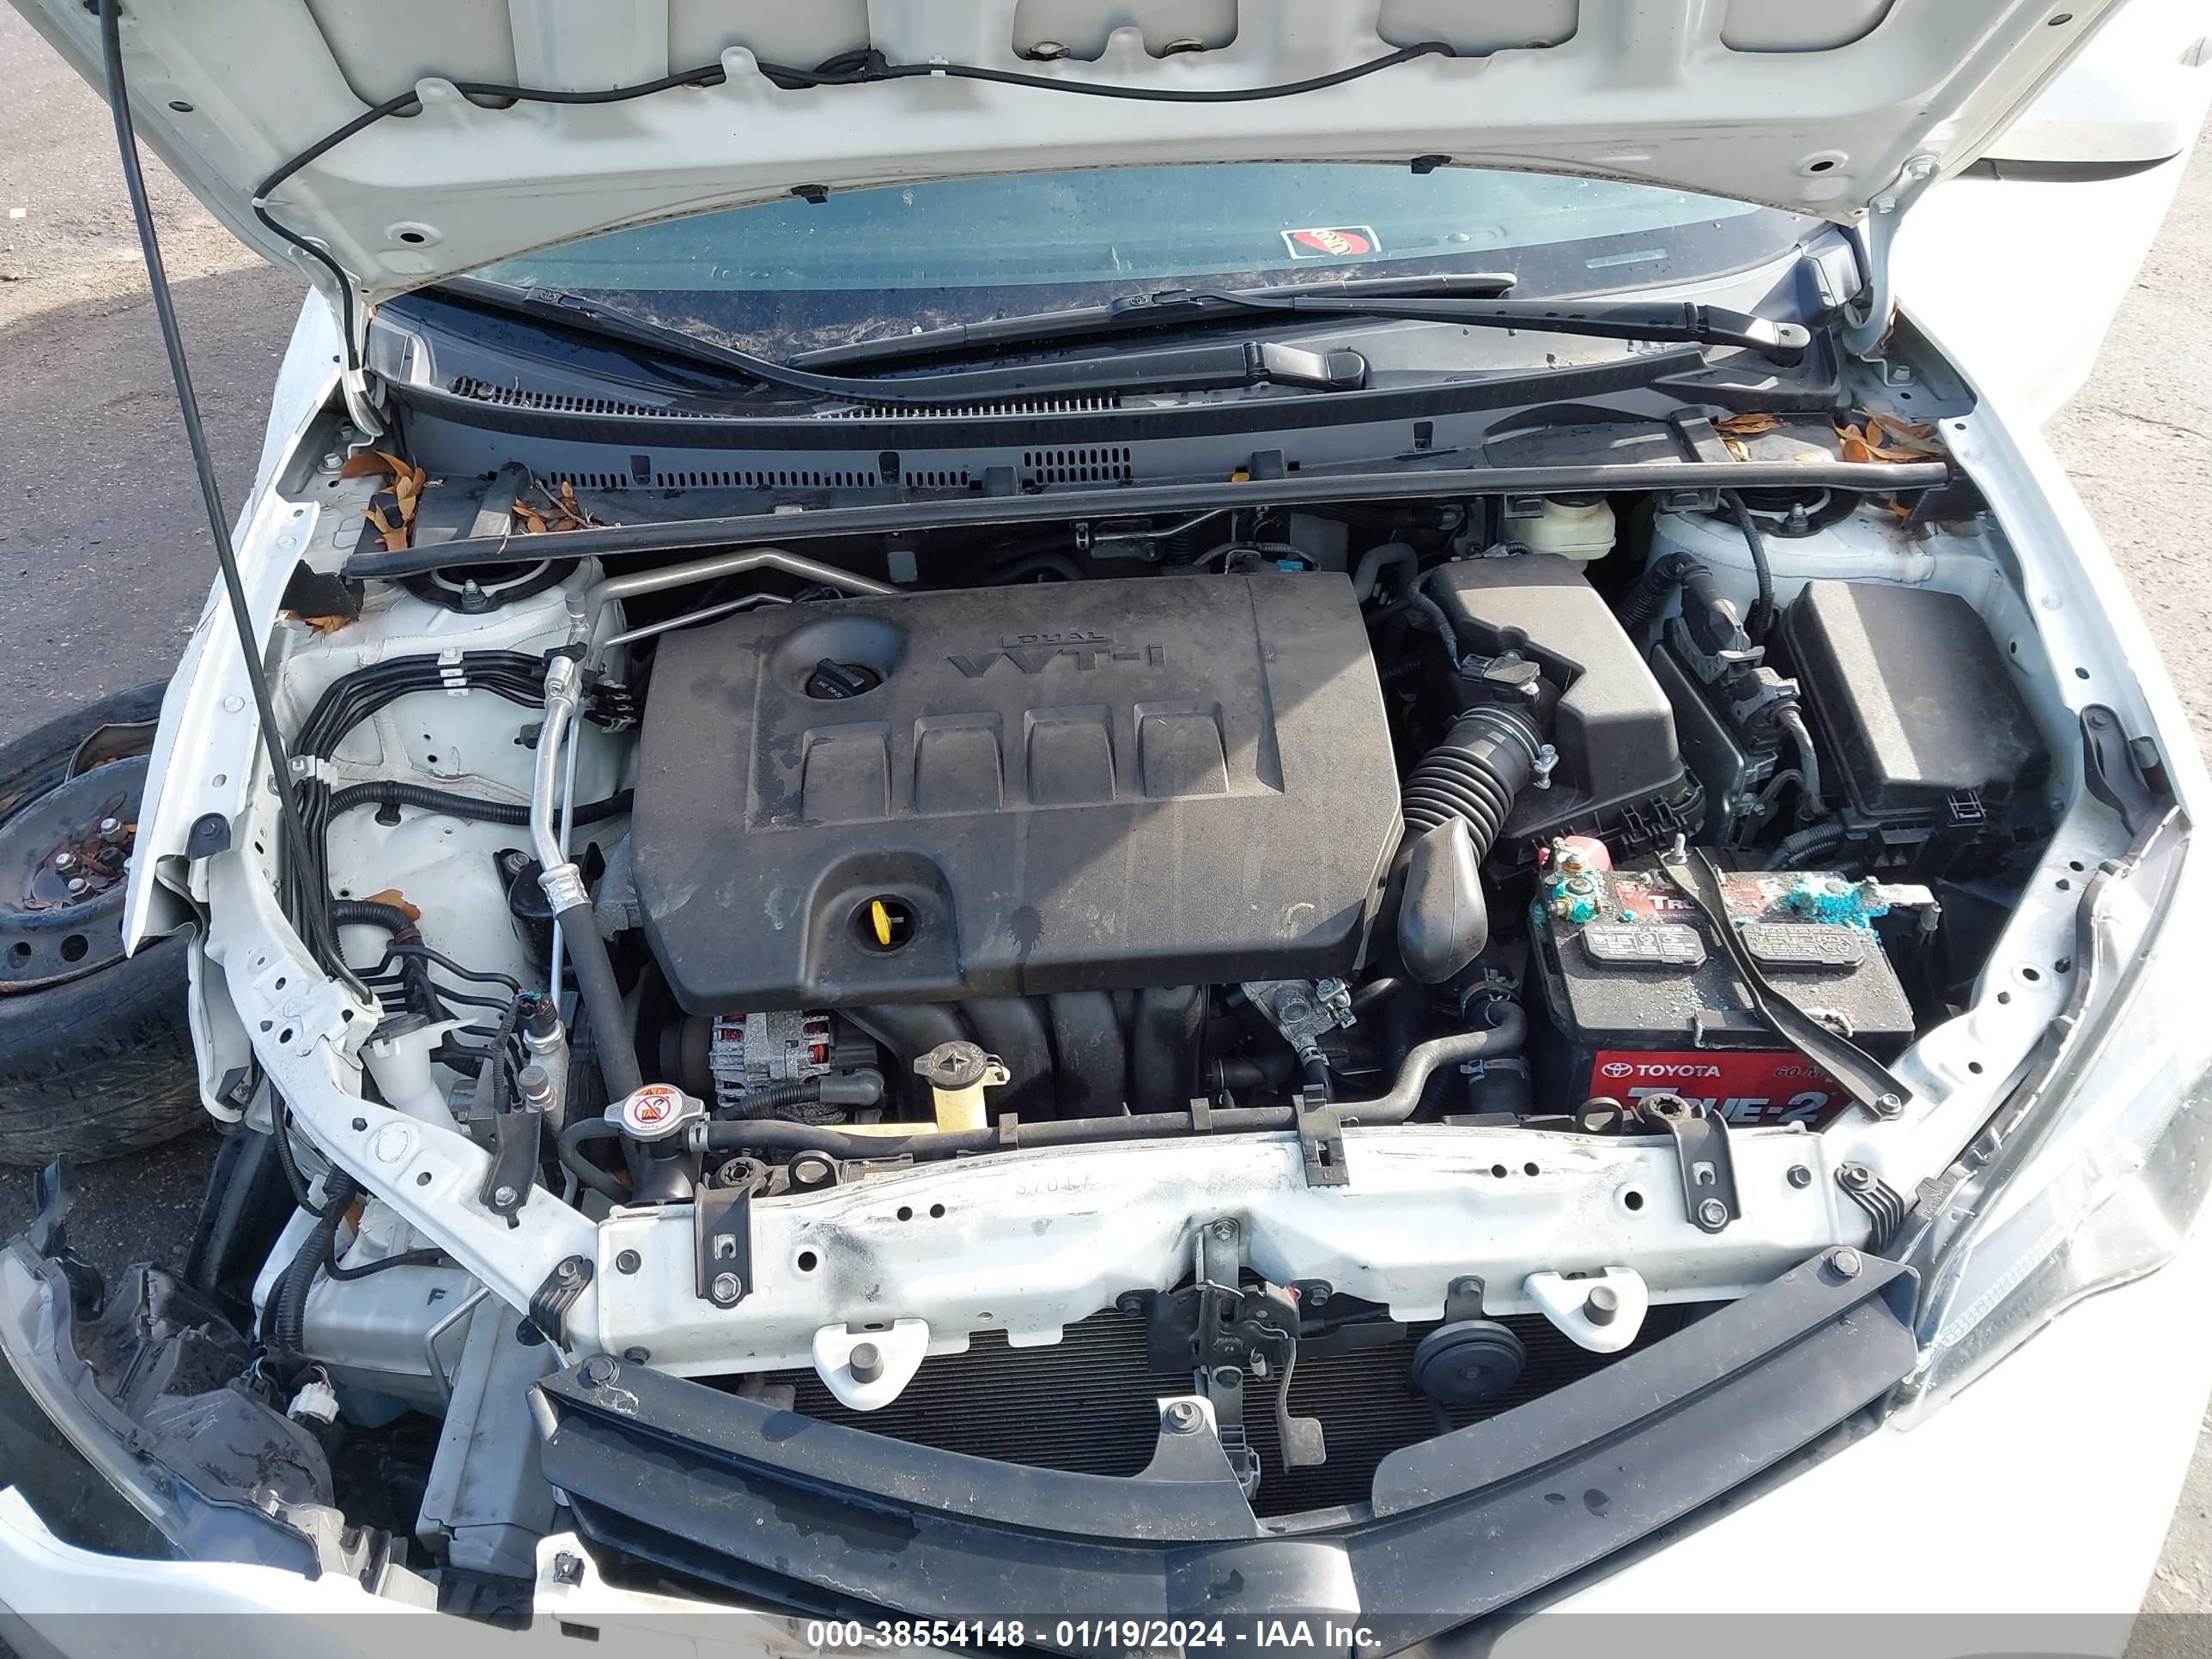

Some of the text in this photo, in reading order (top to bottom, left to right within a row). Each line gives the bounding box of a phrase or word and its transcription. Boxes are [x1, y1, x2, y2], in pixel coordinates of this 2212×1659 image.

[1018, 631, 1105, 644] DUAL
[1636, 1064, 1722, 1078] TOYOTA
[1626, 1086, 1829, 1123] TUE-2
